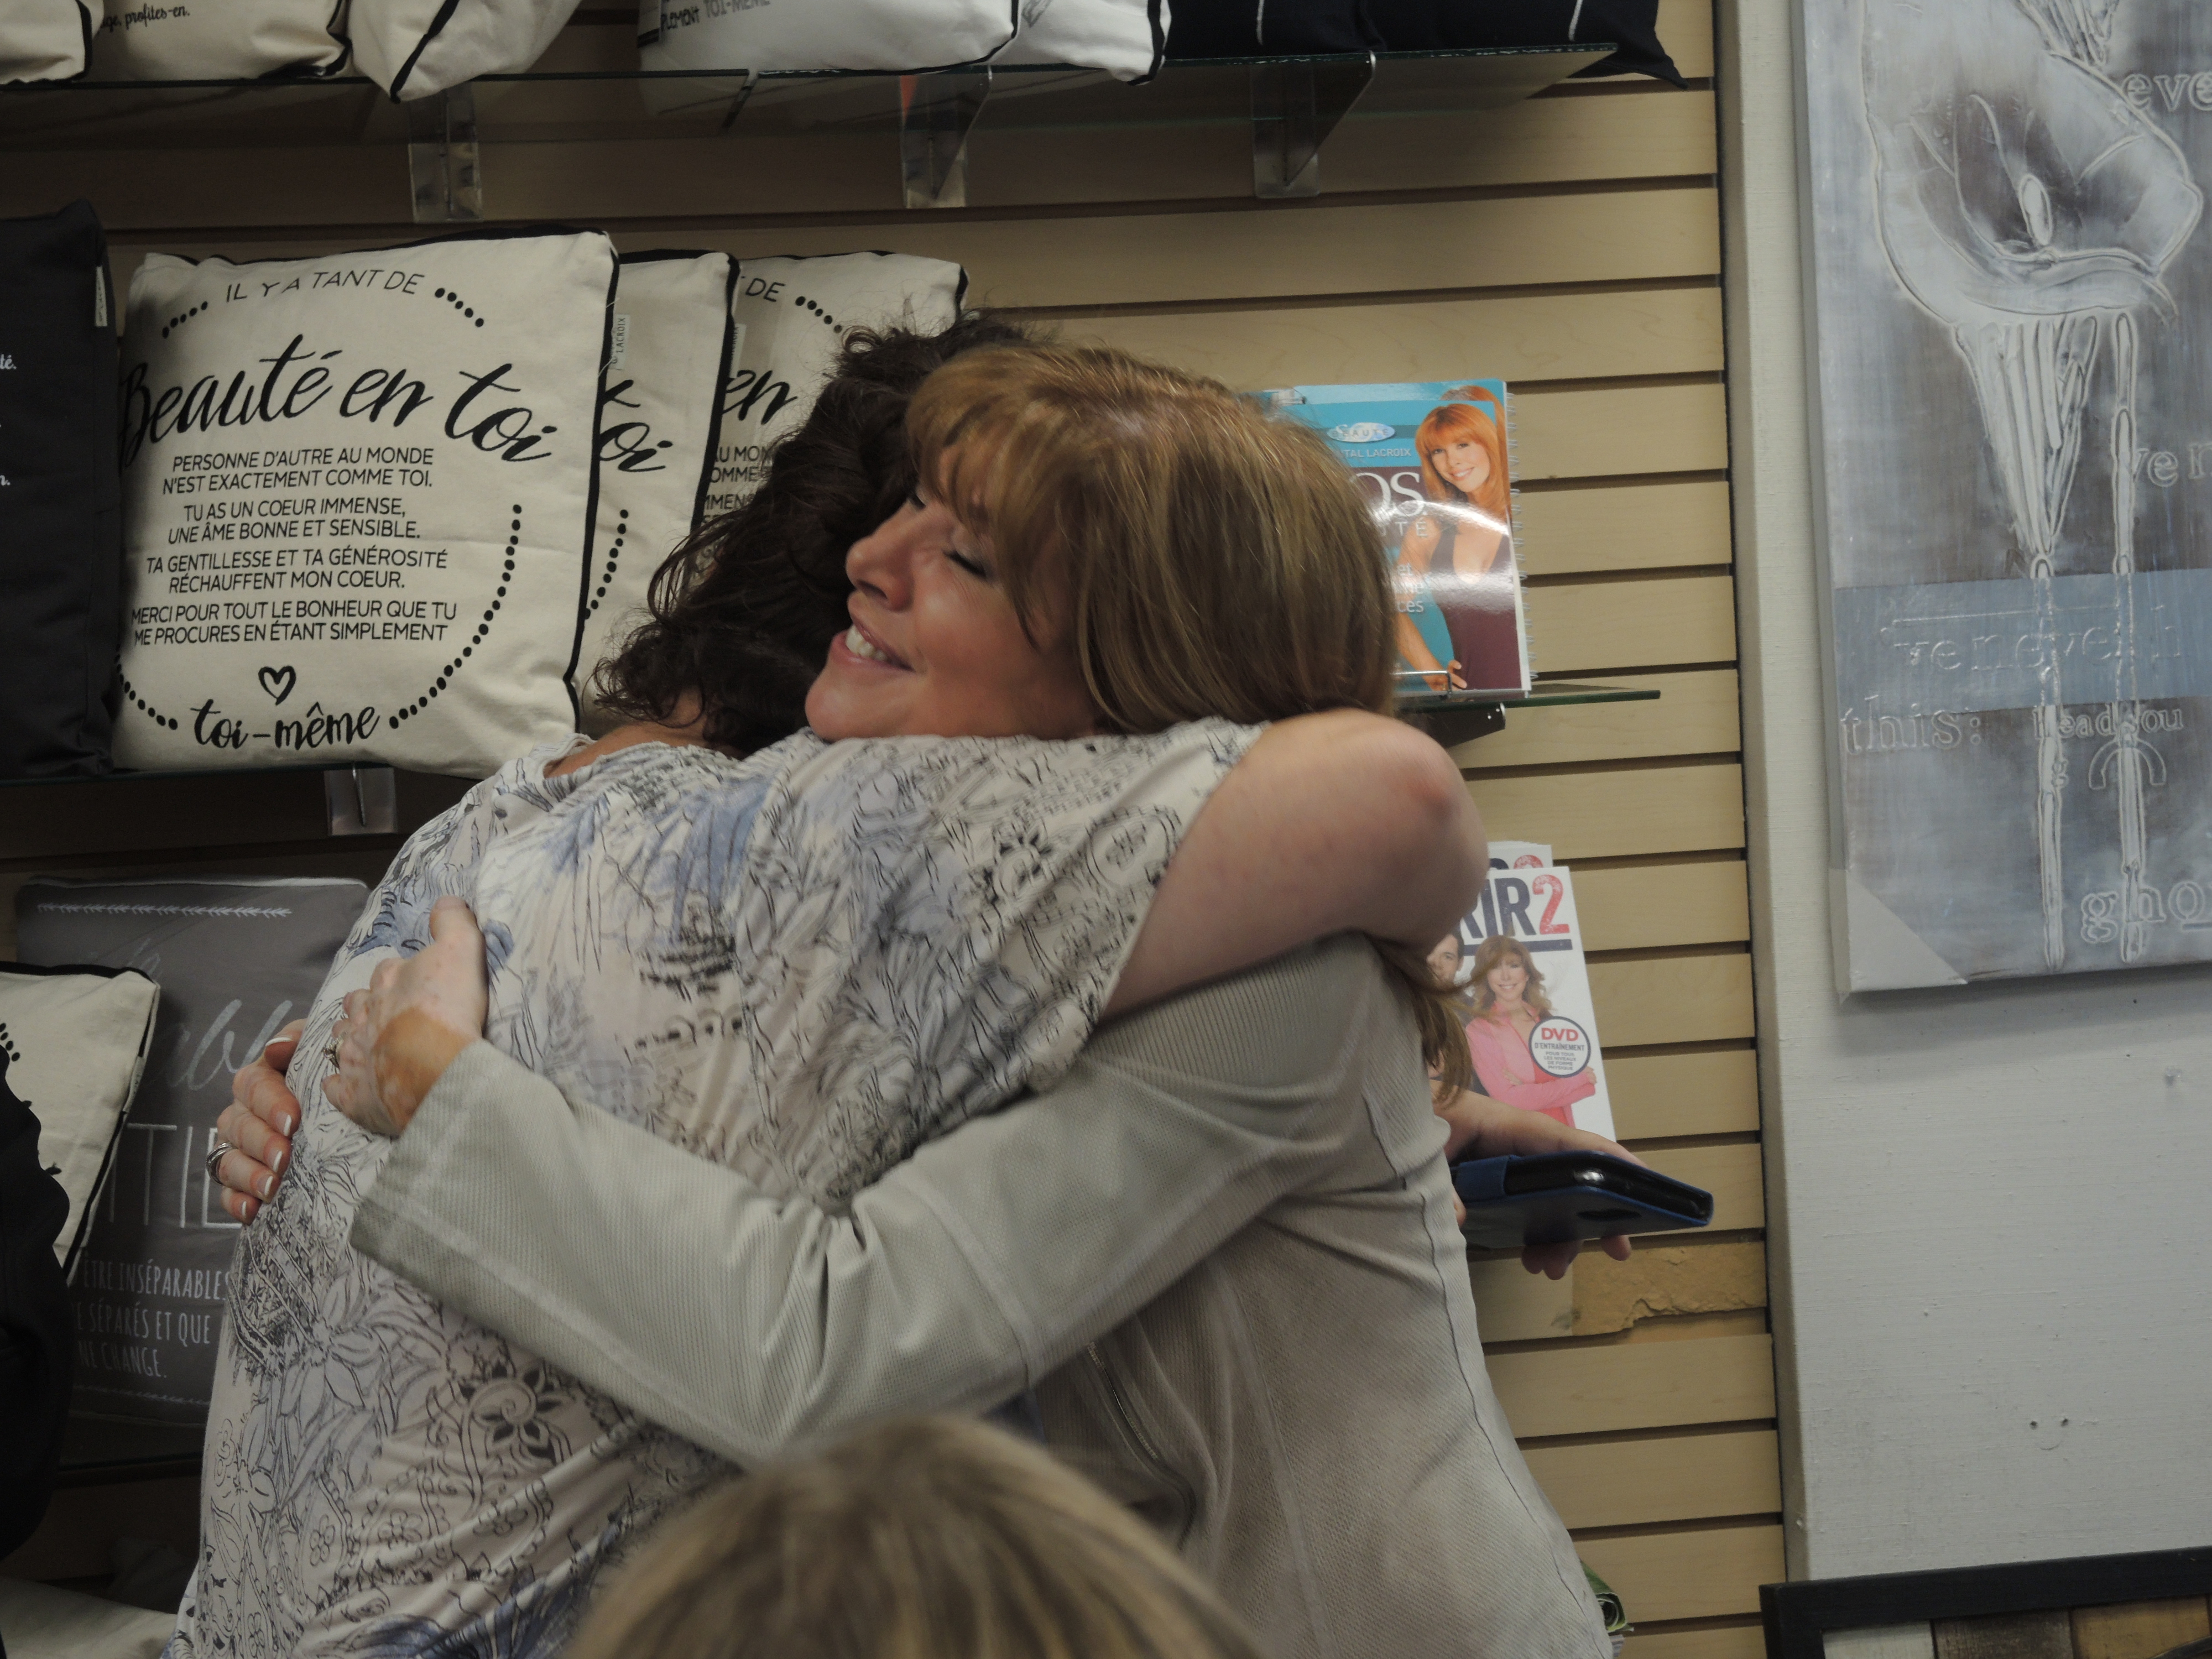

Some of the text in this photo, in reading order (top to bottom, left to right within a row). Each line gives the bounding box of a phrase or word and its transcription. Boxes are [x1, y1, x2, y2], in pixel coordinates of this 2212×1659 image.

[226, 269, 426, 303] IL Y A TANT DE
[745, 277, 786, 302] DE
[615, 317, 626, 353] LACROIX
[118, 333, 558, 469] Beauté en toi
[171, 446, 435, 473] PERSONNE D'AUTRE AU MONDE
[1366, 447, 1412, 457] LACROIX
[162, 468, 432, 495] N'EST EXACTEMENT COMME TOI.
[182, 496, 406, 523] TU AS UN COEUR IMMENSE,
[167, 518, 421, 545] UNE ÂME BONNE ET SENSIBLE.
[146, 544, 448, 575] TA GENTILLESSE ET TA GÉNÉROSITÉ
[168, 570, 405, 594] RÉCHAUFFENT MON COEUR.
[131, 599, 457, 625] MERCI POUR TOUT LE BONHEUR QUE TU
[134, 619, 449, 646] ME PROCURES EN ÉTANT SIMPLEMENT
[190, 697, 382, 750] toi-même
[1541, 1027, 1579, 1042] DVD
[88, 1297, 150, 1339] SÉPARÉS
[155, 1311, 173, 1341] ET
[178, 1312, 211, 1348] QUE
[101, 1342, 168, 1379] CHANGE.
